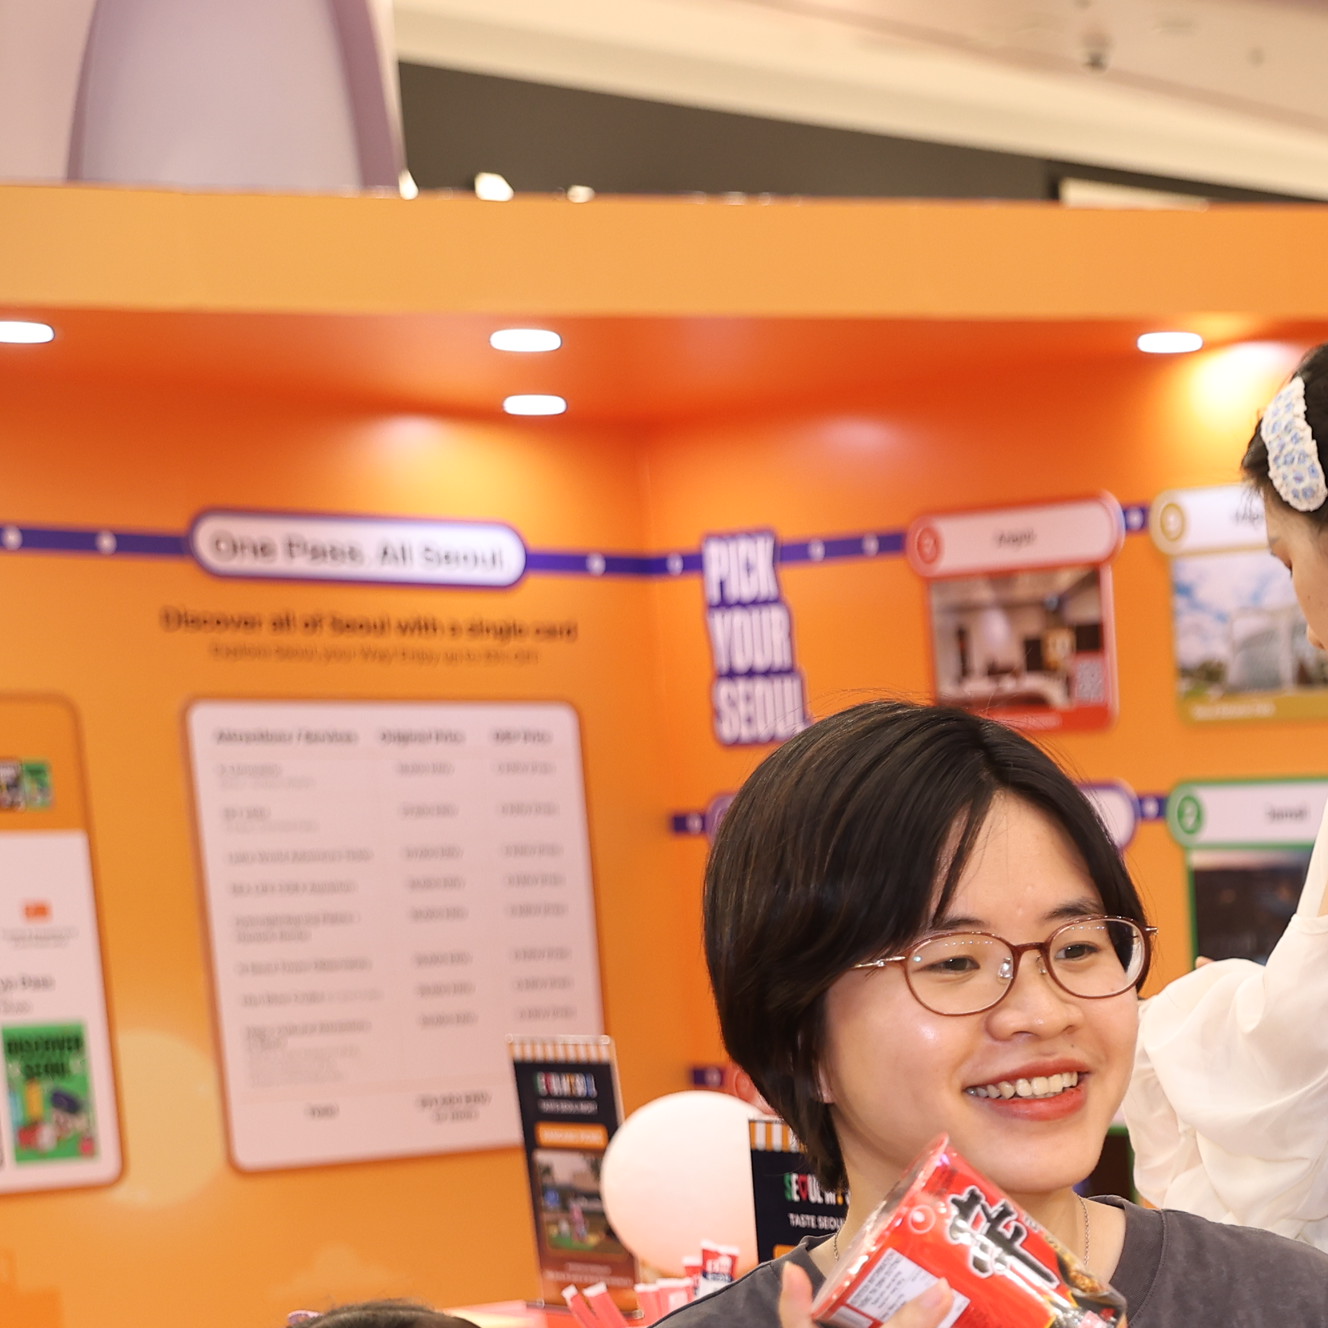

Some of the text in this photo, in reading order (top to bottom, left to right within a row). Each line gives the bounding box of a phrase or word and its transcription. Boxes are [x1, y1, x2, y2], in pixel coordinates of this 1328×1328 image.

[704, 534, 778, 605] PICK
[709, 605, 793, 674] YOUR
[715, 674, 806, 744] SEOUL
[788, 1213, 845, 1231] TASTE SEOU
